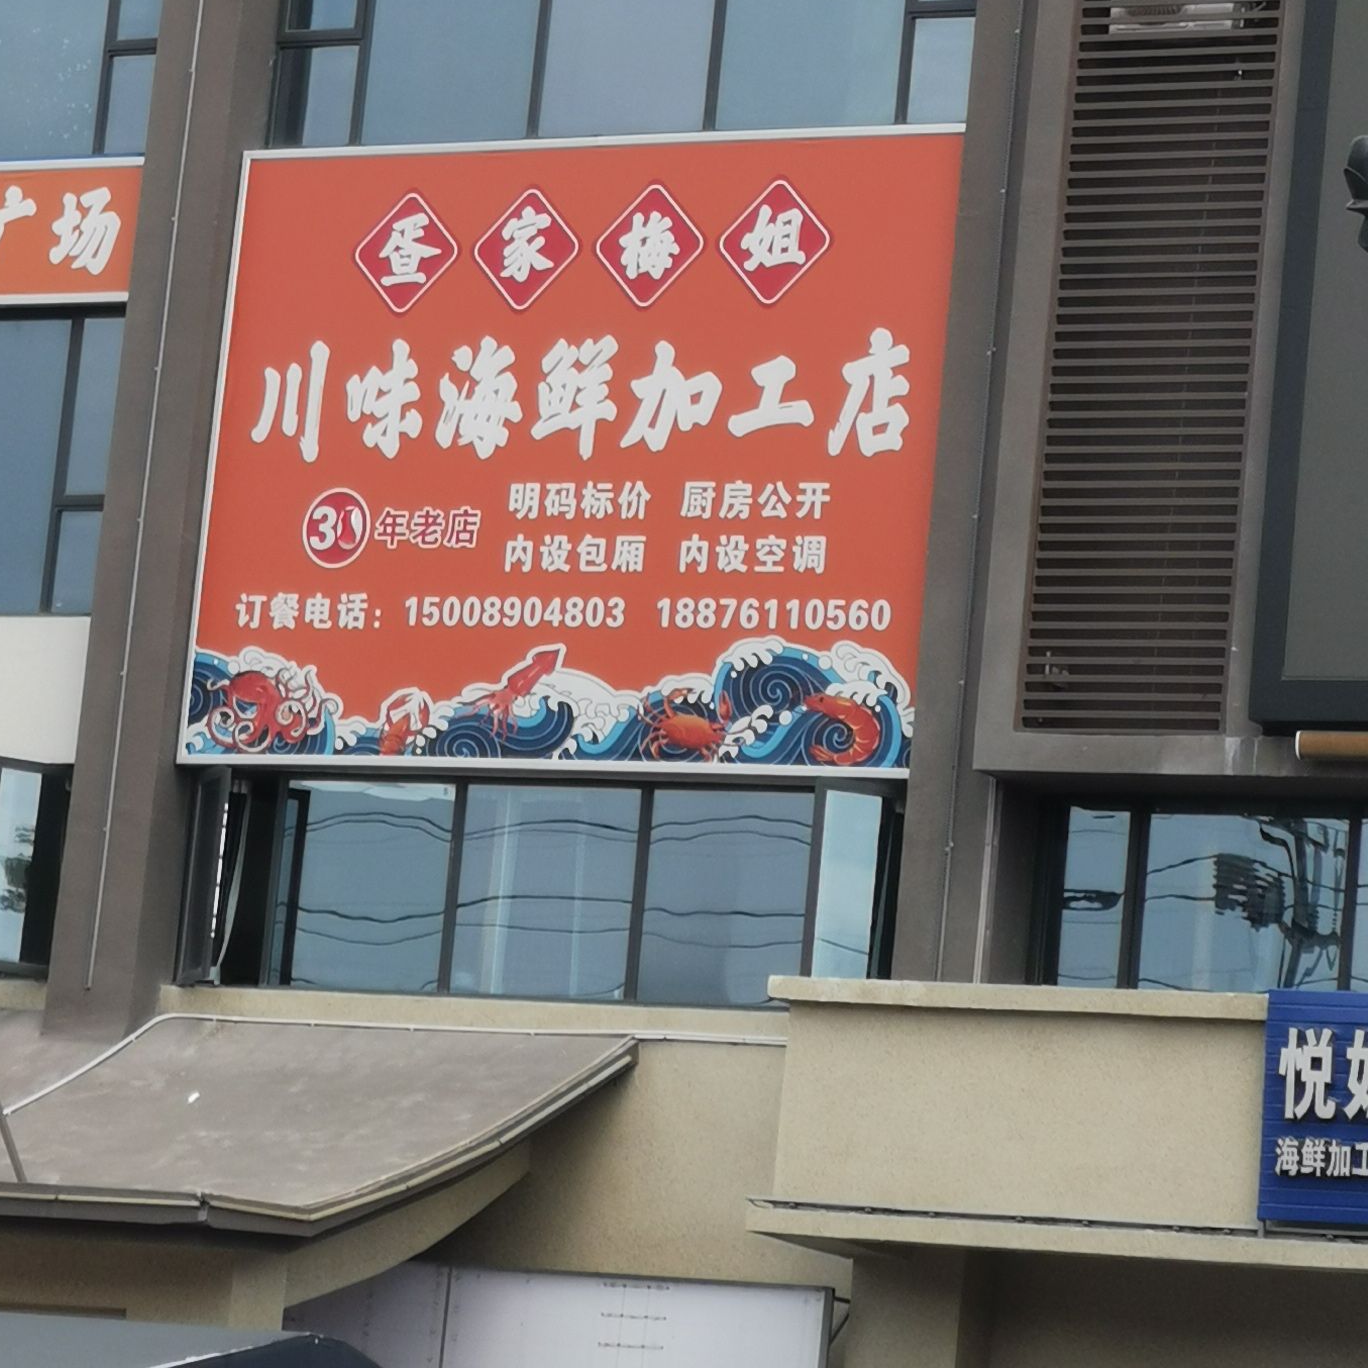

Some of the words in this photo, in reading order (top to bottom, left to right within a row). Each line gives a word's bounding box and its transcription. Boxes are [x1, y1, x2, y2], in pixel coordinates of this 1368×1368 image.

[249, 326, 912, 464] 川味海鲜加工店
[506, 479, 652, 521] 明码标价
[678, 479, 832, 522] 厨房公开
[502, 533, 647, 574] 内设包厢
[677, 533, 828, 576] 内设空调
[403, 594, 627, 629] 15008904803
[655, 596, 893, 633] 18876110560
